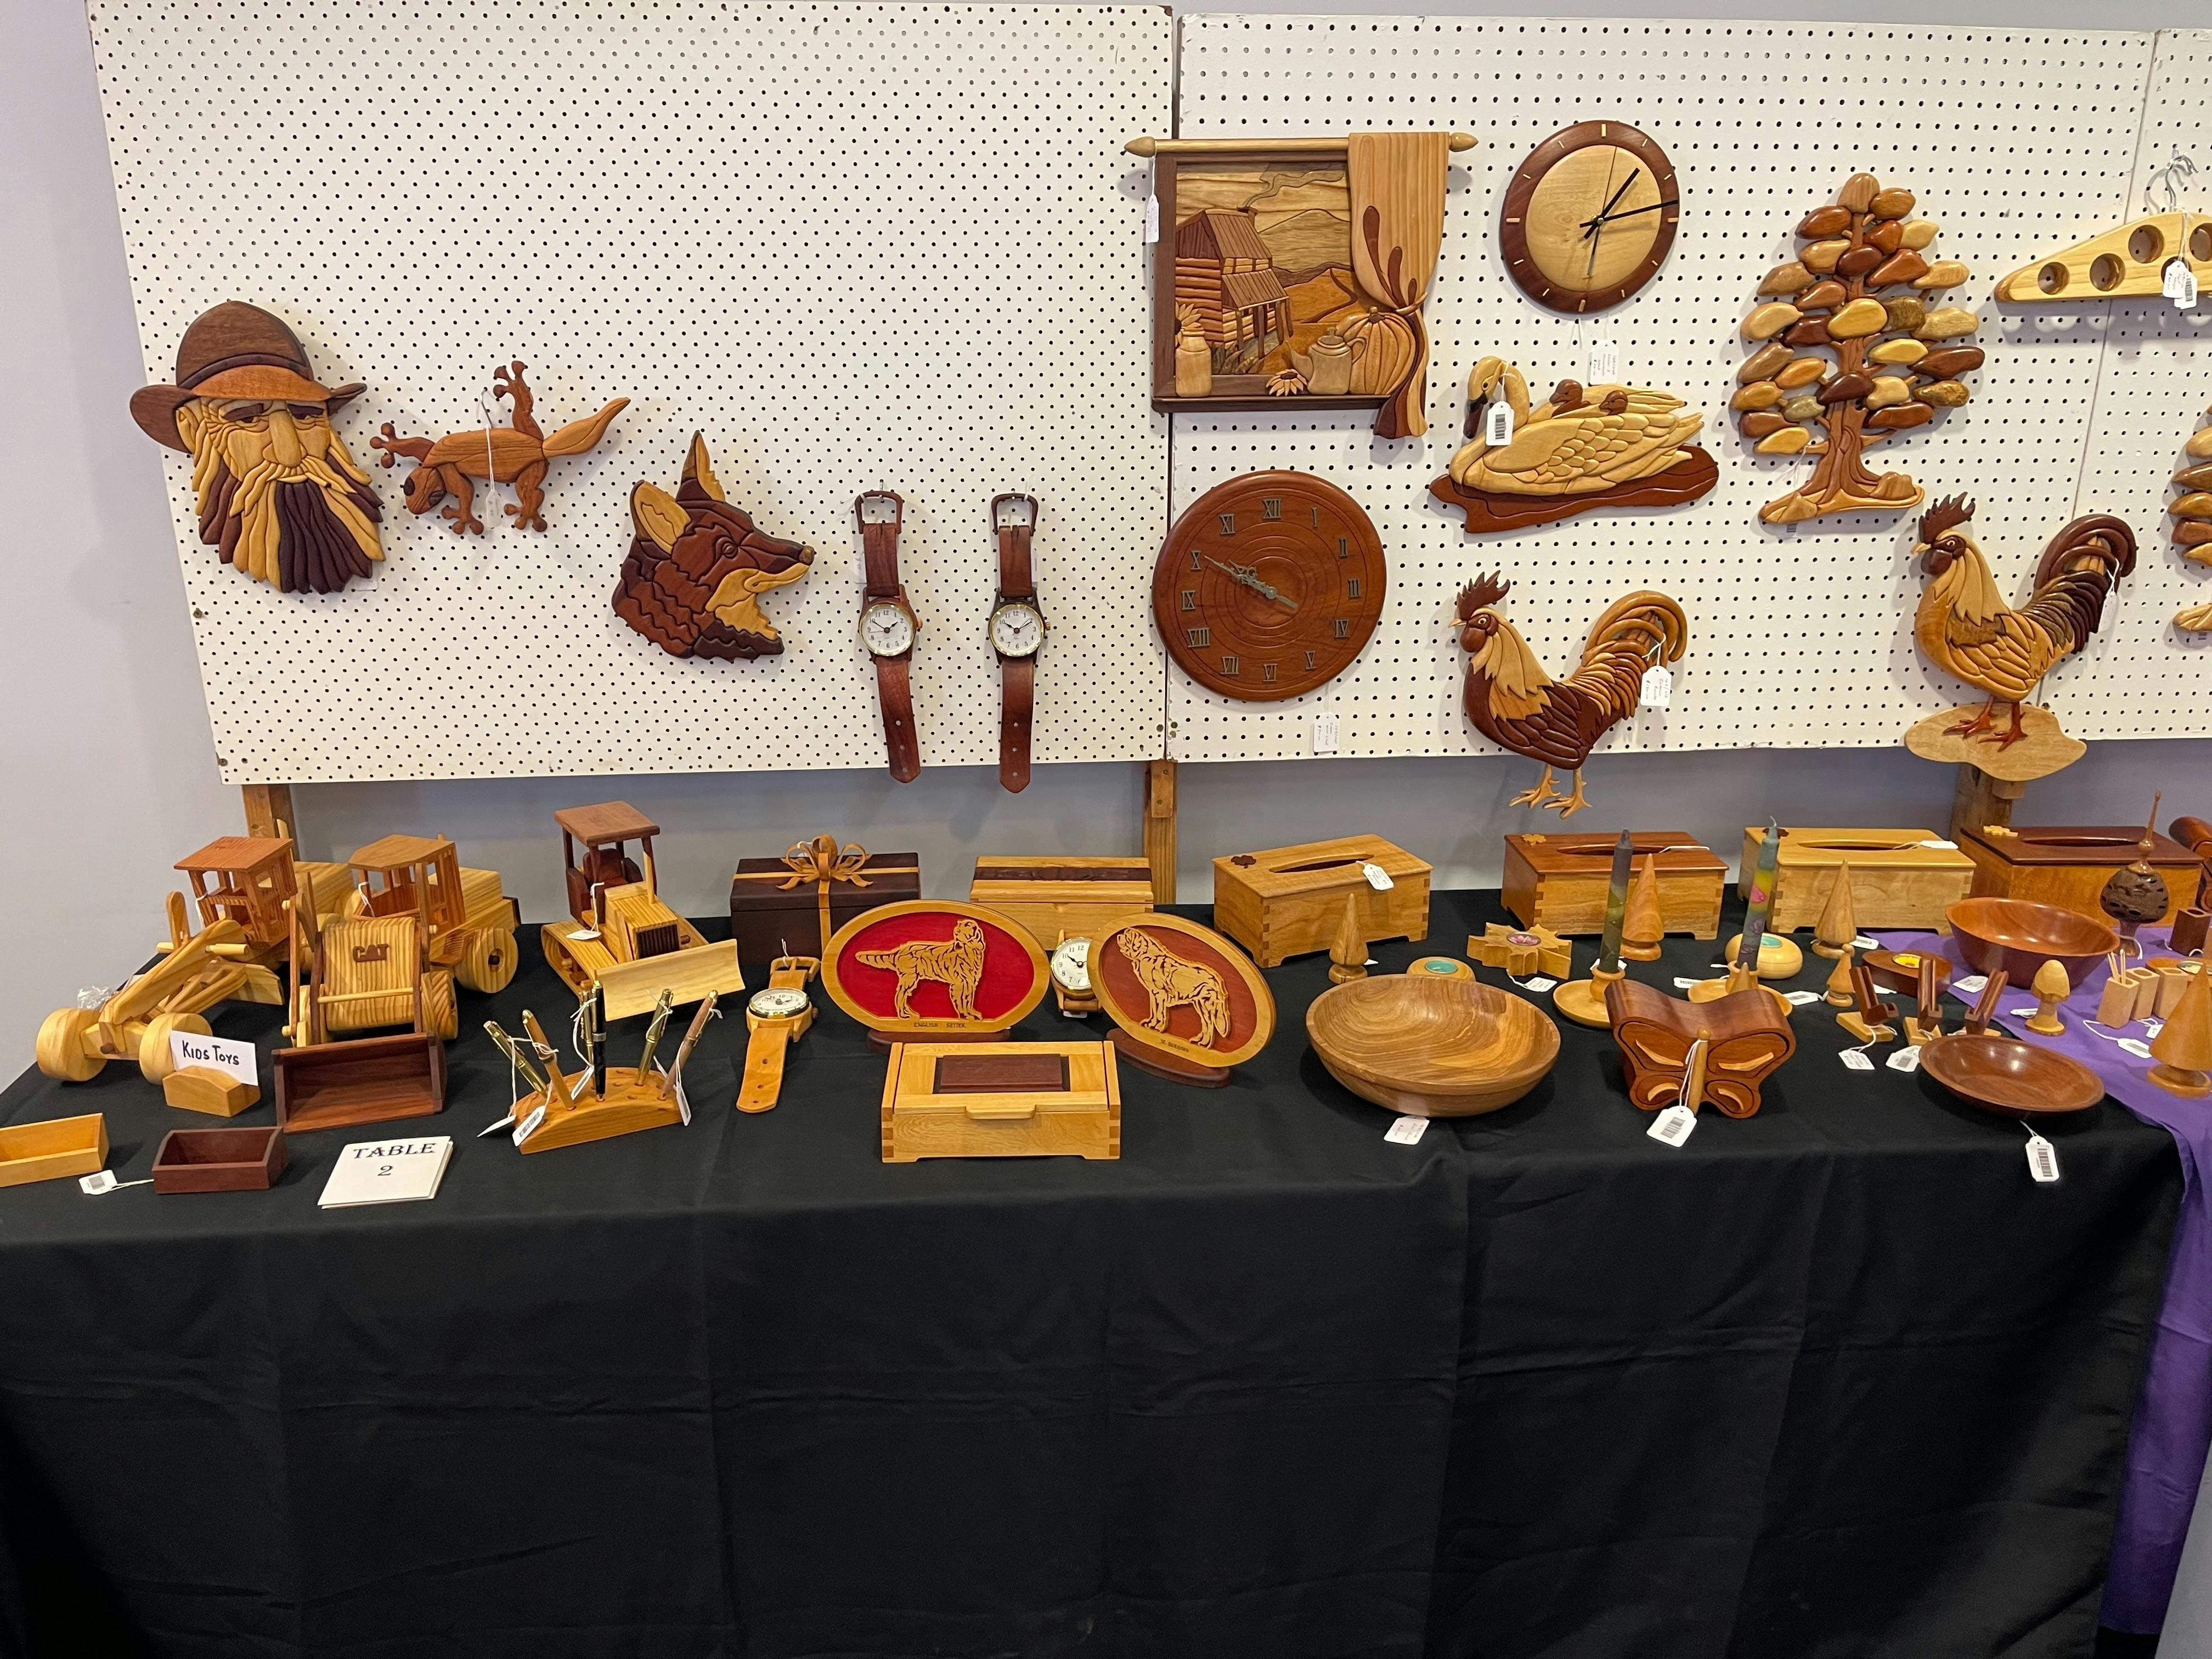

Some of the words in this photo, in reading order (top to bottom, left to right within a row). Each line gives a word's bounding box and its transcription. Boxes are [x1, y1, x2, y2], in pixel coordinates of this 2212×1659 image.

[1262, 499, 1281, 519] XII
[1312, 507, 1317, 527] I
[1220, 514, 1235, 534] XI
[1339, 537, 1347, 558] II
[1191, 550, 1201, 570] X
[1348, 578, 1361, 599] III
[1181, 590, 1196, 610] IX
[1187, 628, 1210, 647] VIII
[1335, 619, 1350, 639] IV
[1221, 656, 1239, 674] VII
[1305, 651, 1316, 670] V
[1263, 664, 1277, 681] VI
[353, 944, 388, 963] CAT
[353, 1143, 437, 1159] TABLE
[377, 1165, 394, 1176] 2
